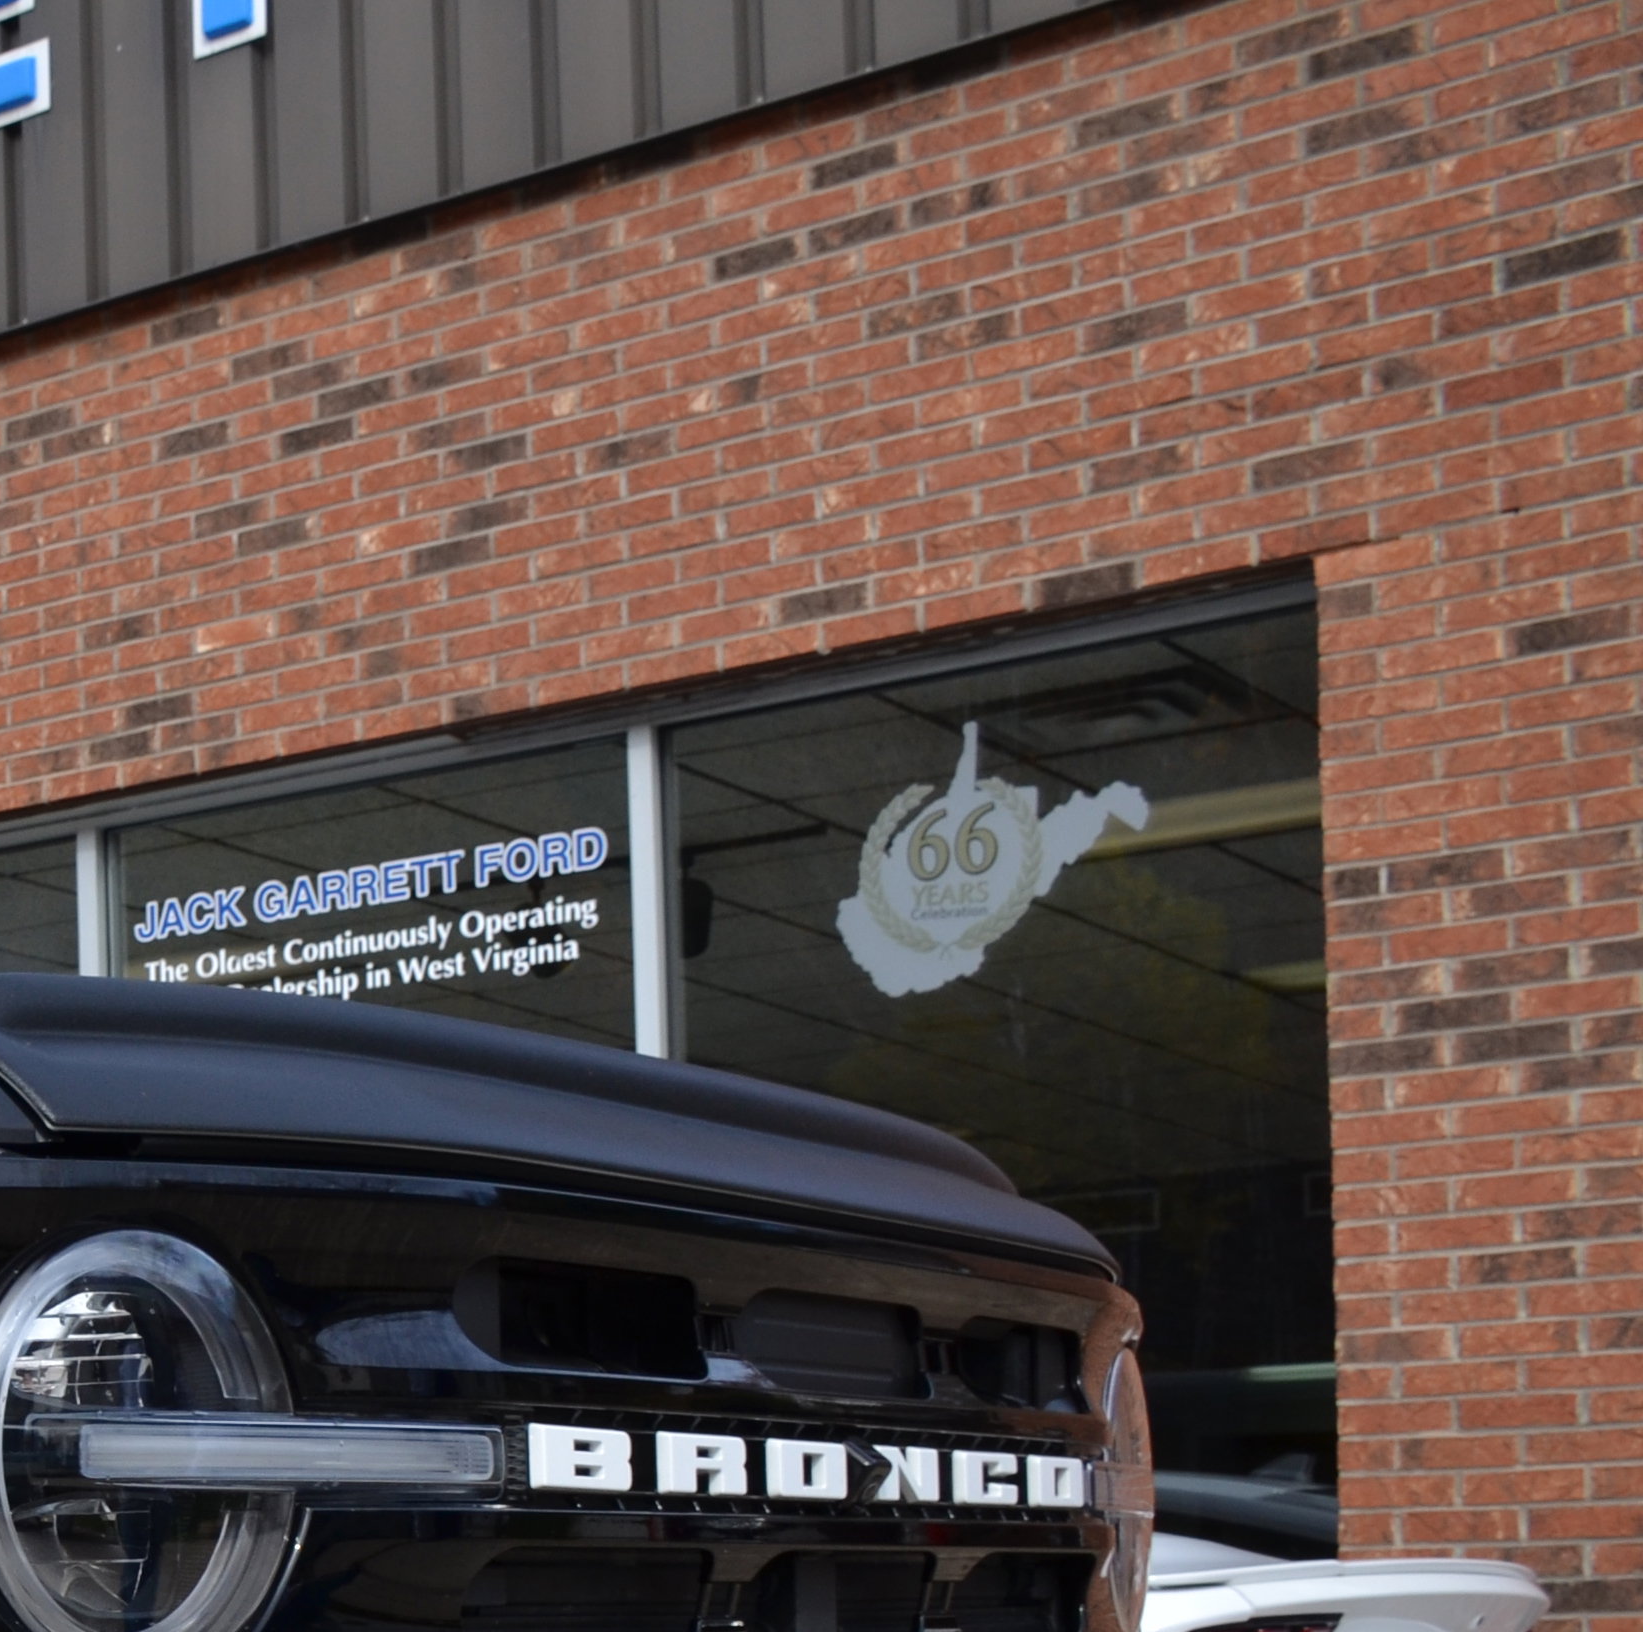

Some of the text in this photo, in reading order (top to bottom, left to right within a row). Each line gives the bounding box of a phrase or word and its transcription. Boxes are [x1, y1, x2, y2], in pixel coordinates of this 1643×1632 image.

[907, 800, 999, 882] 66
[134, 826, 608, 943] JACK GARRETT FORD
[911, 881, 990, 907] YEARS
[144, 958, 189, 983] The
[283, 914, 453, 964] Continuously
[459, 895, 600, 943] Operating
[365, 961, 392, 990] in
[397, 950, 467, 984] West
[471, 933, 580, 977] Virginia
[528, 1421, 1085, 1508] BRONCO
